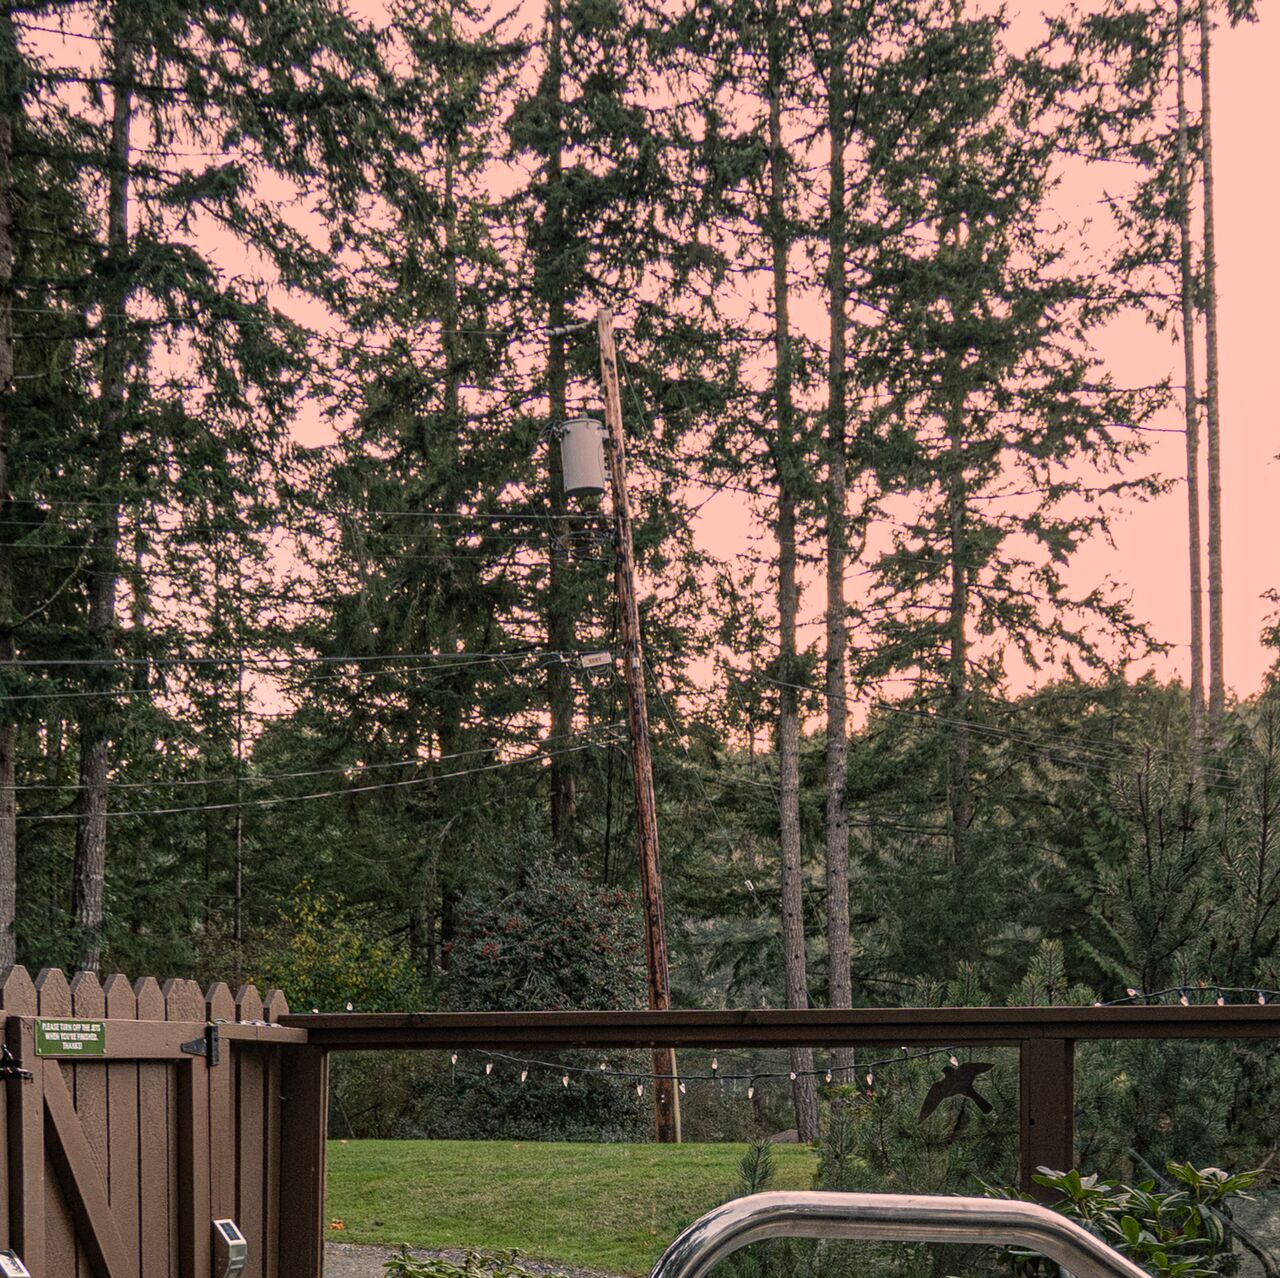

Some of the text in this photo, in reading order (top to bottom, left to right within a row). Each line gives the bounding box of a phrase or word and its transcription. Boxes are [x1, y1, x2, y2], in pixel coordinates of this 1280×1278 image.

[42, 1023, 59, 1031] PLEASE
[72, 1023, 81, 1031] OFF
[82, 1023, 90, 1032] THE
